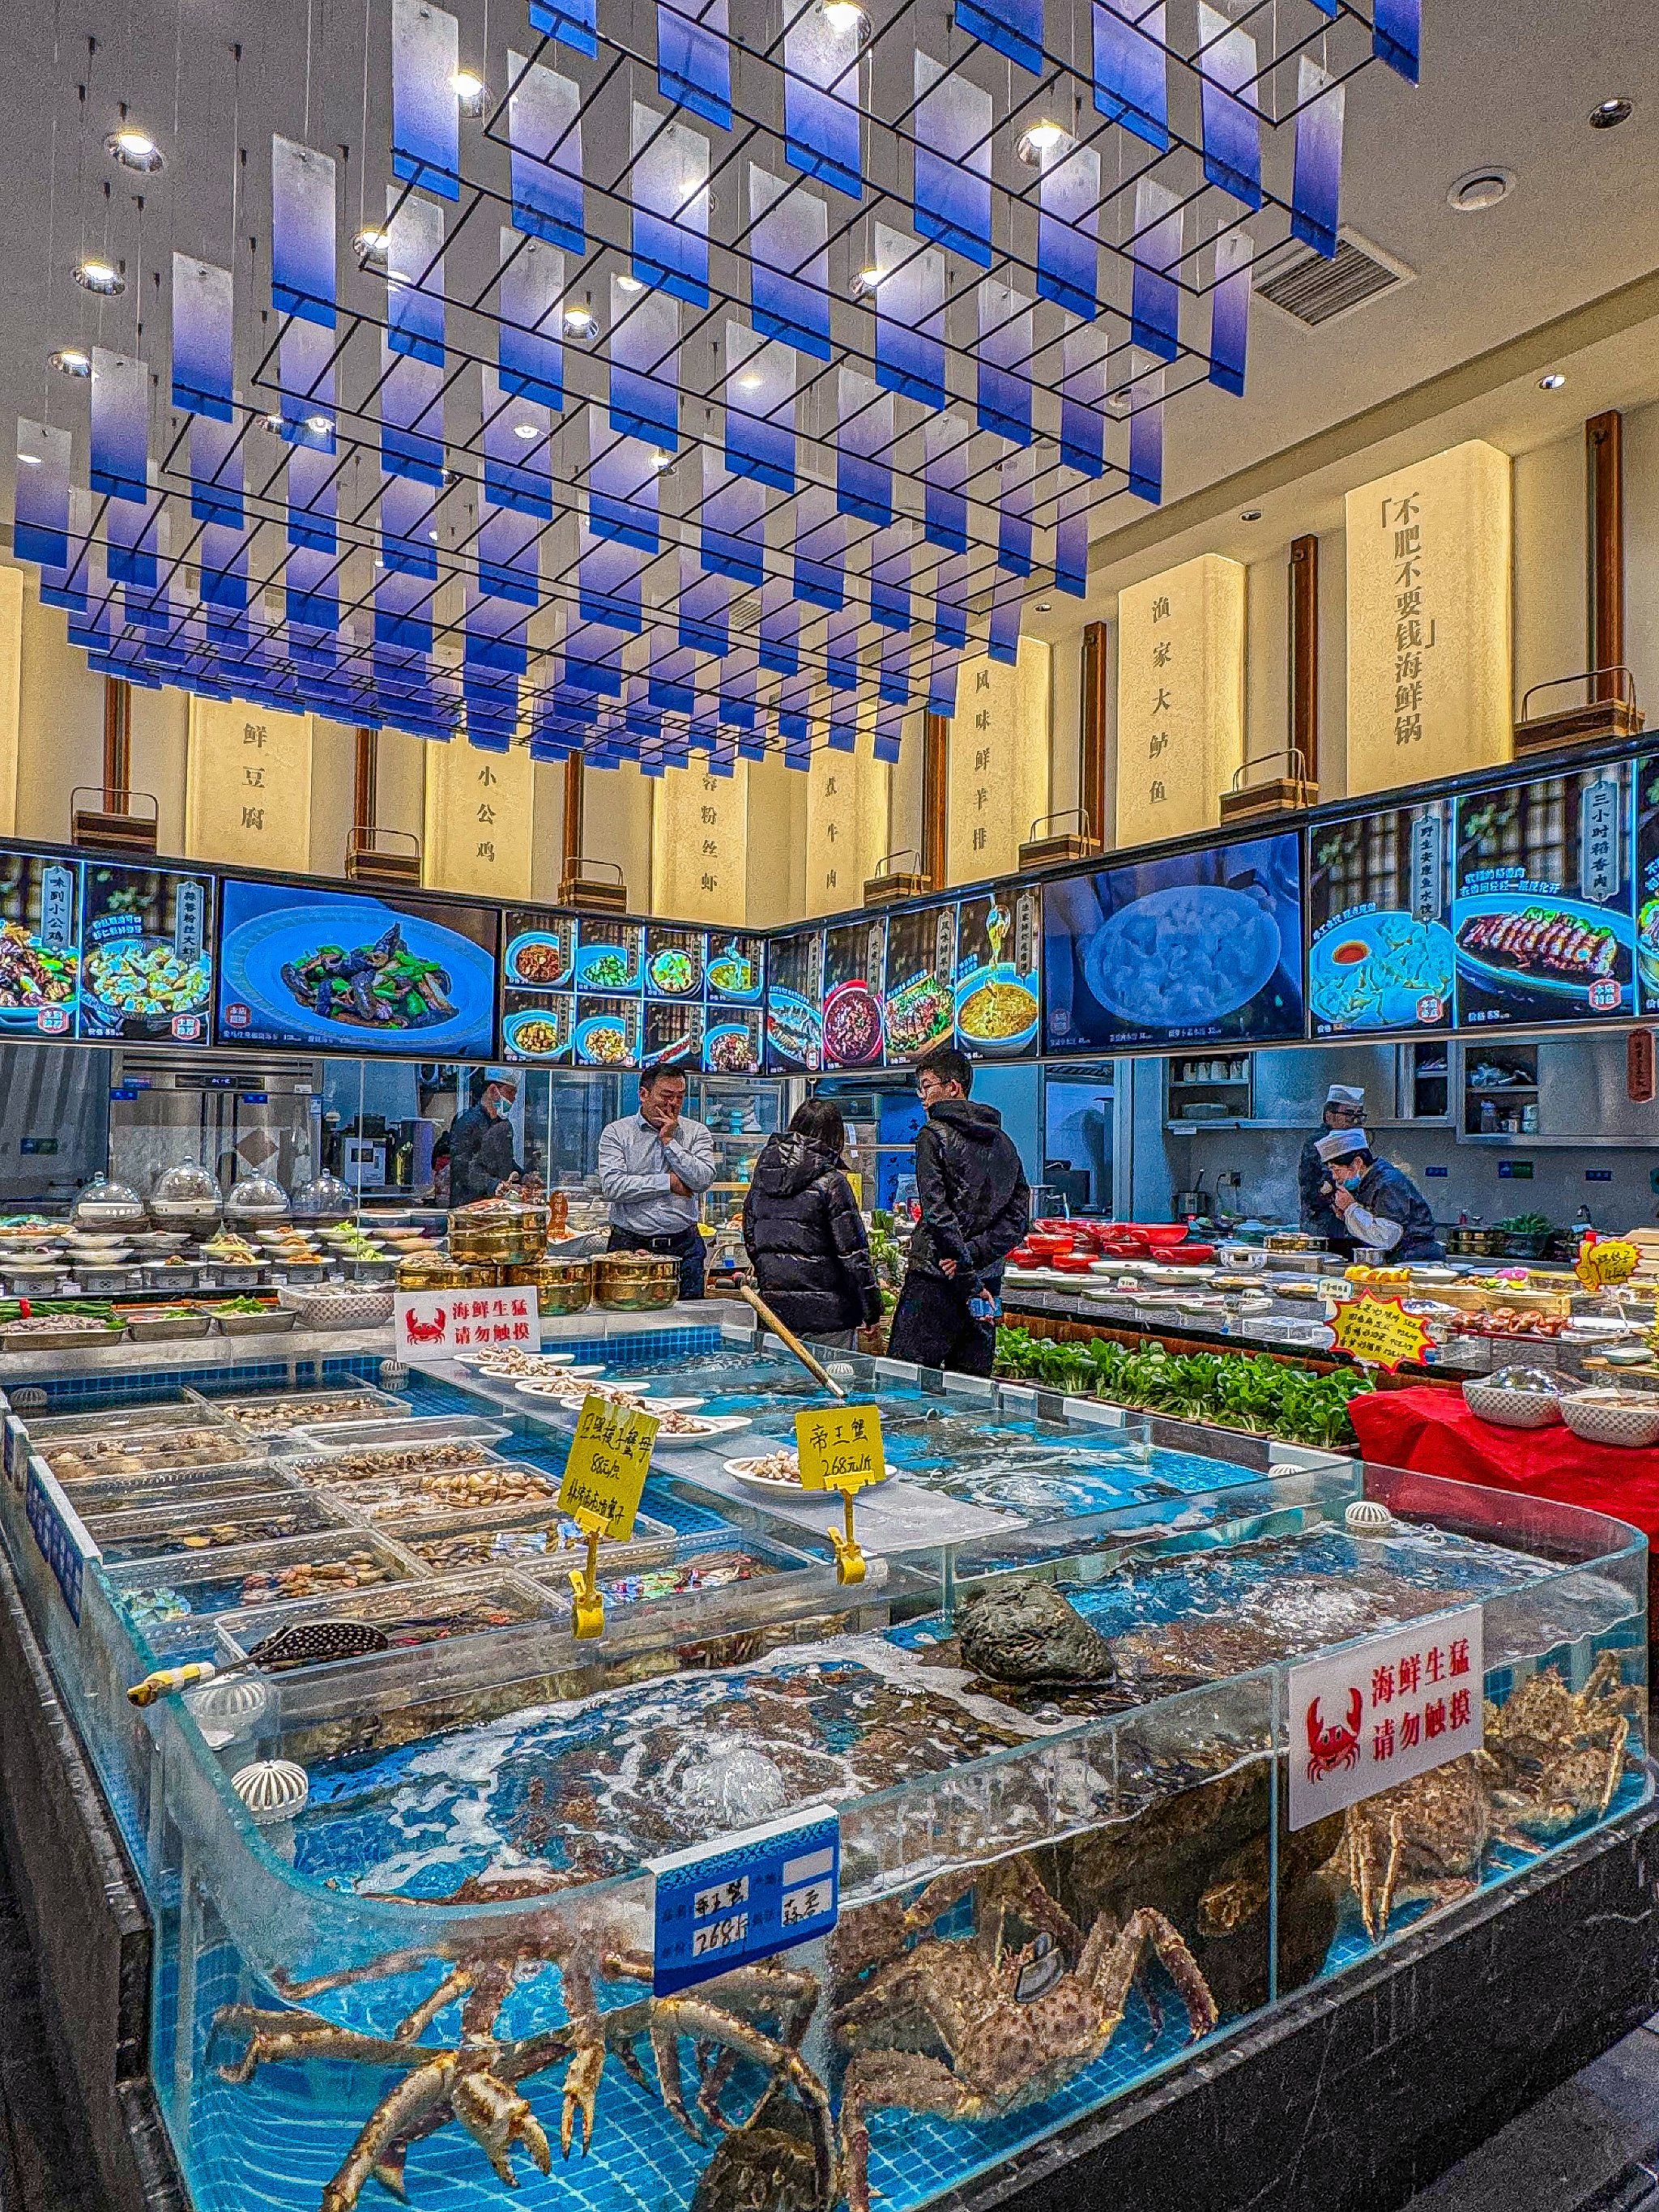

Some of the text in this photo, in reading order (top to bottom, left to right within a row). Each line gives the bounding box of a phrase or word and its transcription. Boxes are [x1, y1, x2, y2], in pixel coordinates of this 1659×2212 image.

[1149, 596, 1171, 803] 渔家大鲈鱼
[241, 722, 268, 830] 鲜豆腐
[973, 669, 991, 850] 风味鲜羊排
[476, 765, 497, 863] 小公鸡
[451, 1298, 529, 1319] 海鲜生猛
[454, 1322, 530, 1345] 请勿触摸
[809, 1417, 868, 1457] 帝王蟹
[821, 1453, 872, 1477] 268元/斤
[1371, 1638, 1470, 1707] 海鲜生猛
[1371, 1688, 1470, 1761] 请勿触摸
